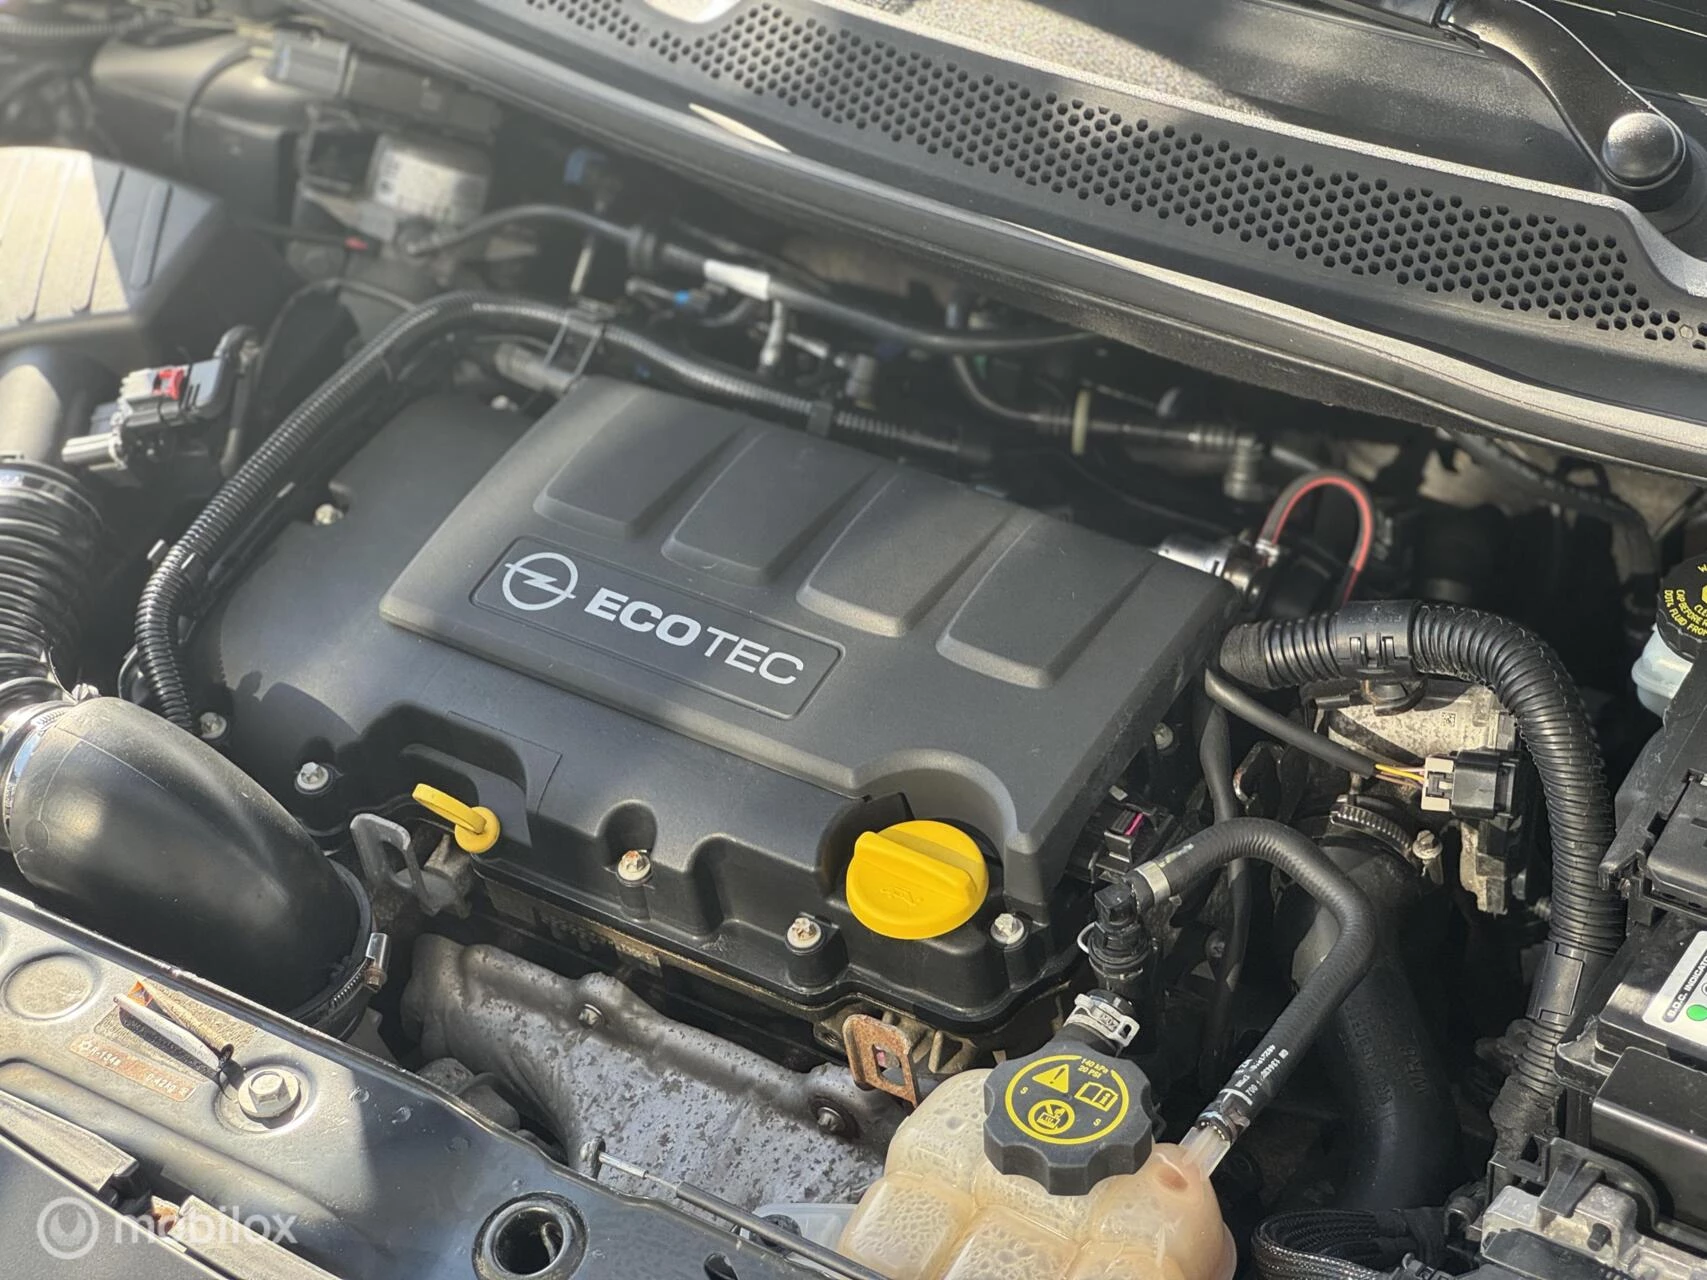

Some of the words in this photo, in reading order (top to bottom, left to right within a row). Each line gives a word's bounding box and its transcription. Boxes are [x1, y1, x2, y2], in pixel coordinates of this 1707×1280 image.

[1669, 607, 1688, 626] FLUID
[584, 587, 804, 685] ECOTEC
[1081, 1058, 1094, 1068] 140
[1078, 1065, 1088, 1074] 20
[1087, 1068, 1102, 1079] PSI
